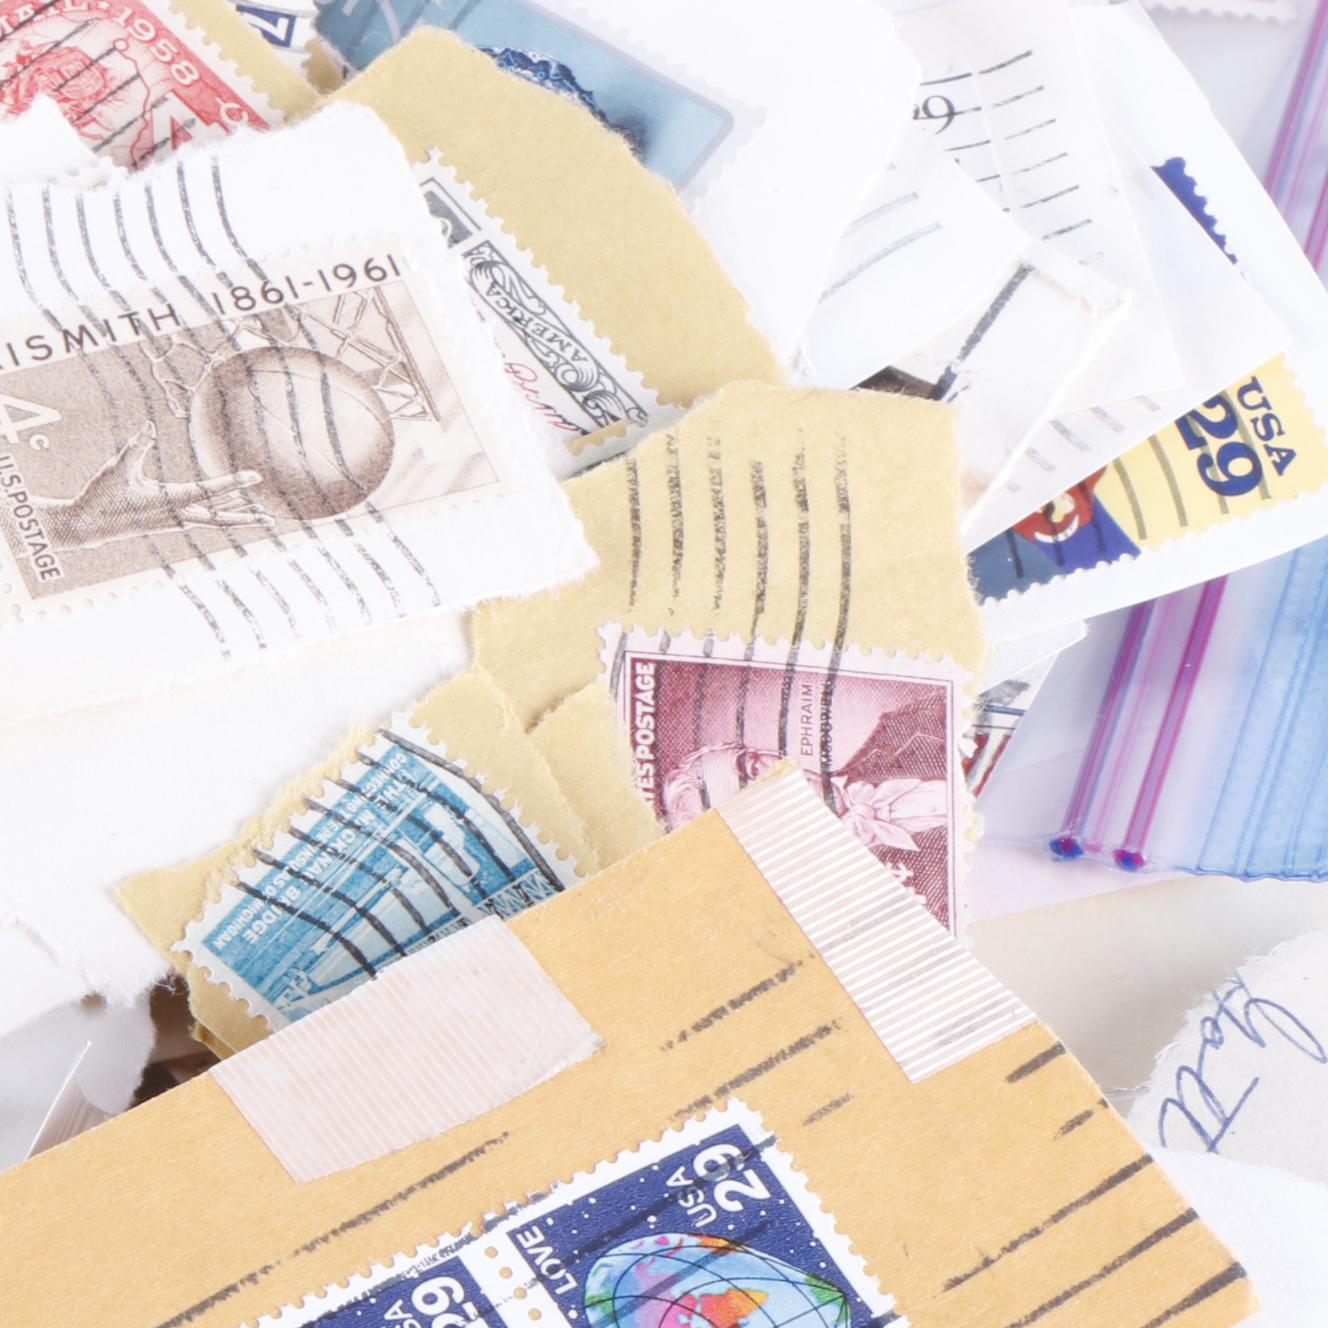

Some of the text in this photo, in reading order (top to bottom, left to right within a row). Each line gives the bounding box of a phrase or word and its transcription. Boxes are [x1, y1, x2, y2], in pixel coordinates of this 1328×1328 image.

[112, 7, 201, 86] 1958
[211, 253, 403, 319] 1861-1961
[485, 281, 590, 365] AMERICA
[1174, 392, 1263, 497] 29
[1236, 374, 1298, 478] USA
[635, 661, 656, 760] POSTAGE
[800, 683, 813, 757] EPHRAIM
[666, 1169, 718, 1228] USA
[691, 1141, 774, 1214] 29
[515, 1223, 578, 1294] LOVE
